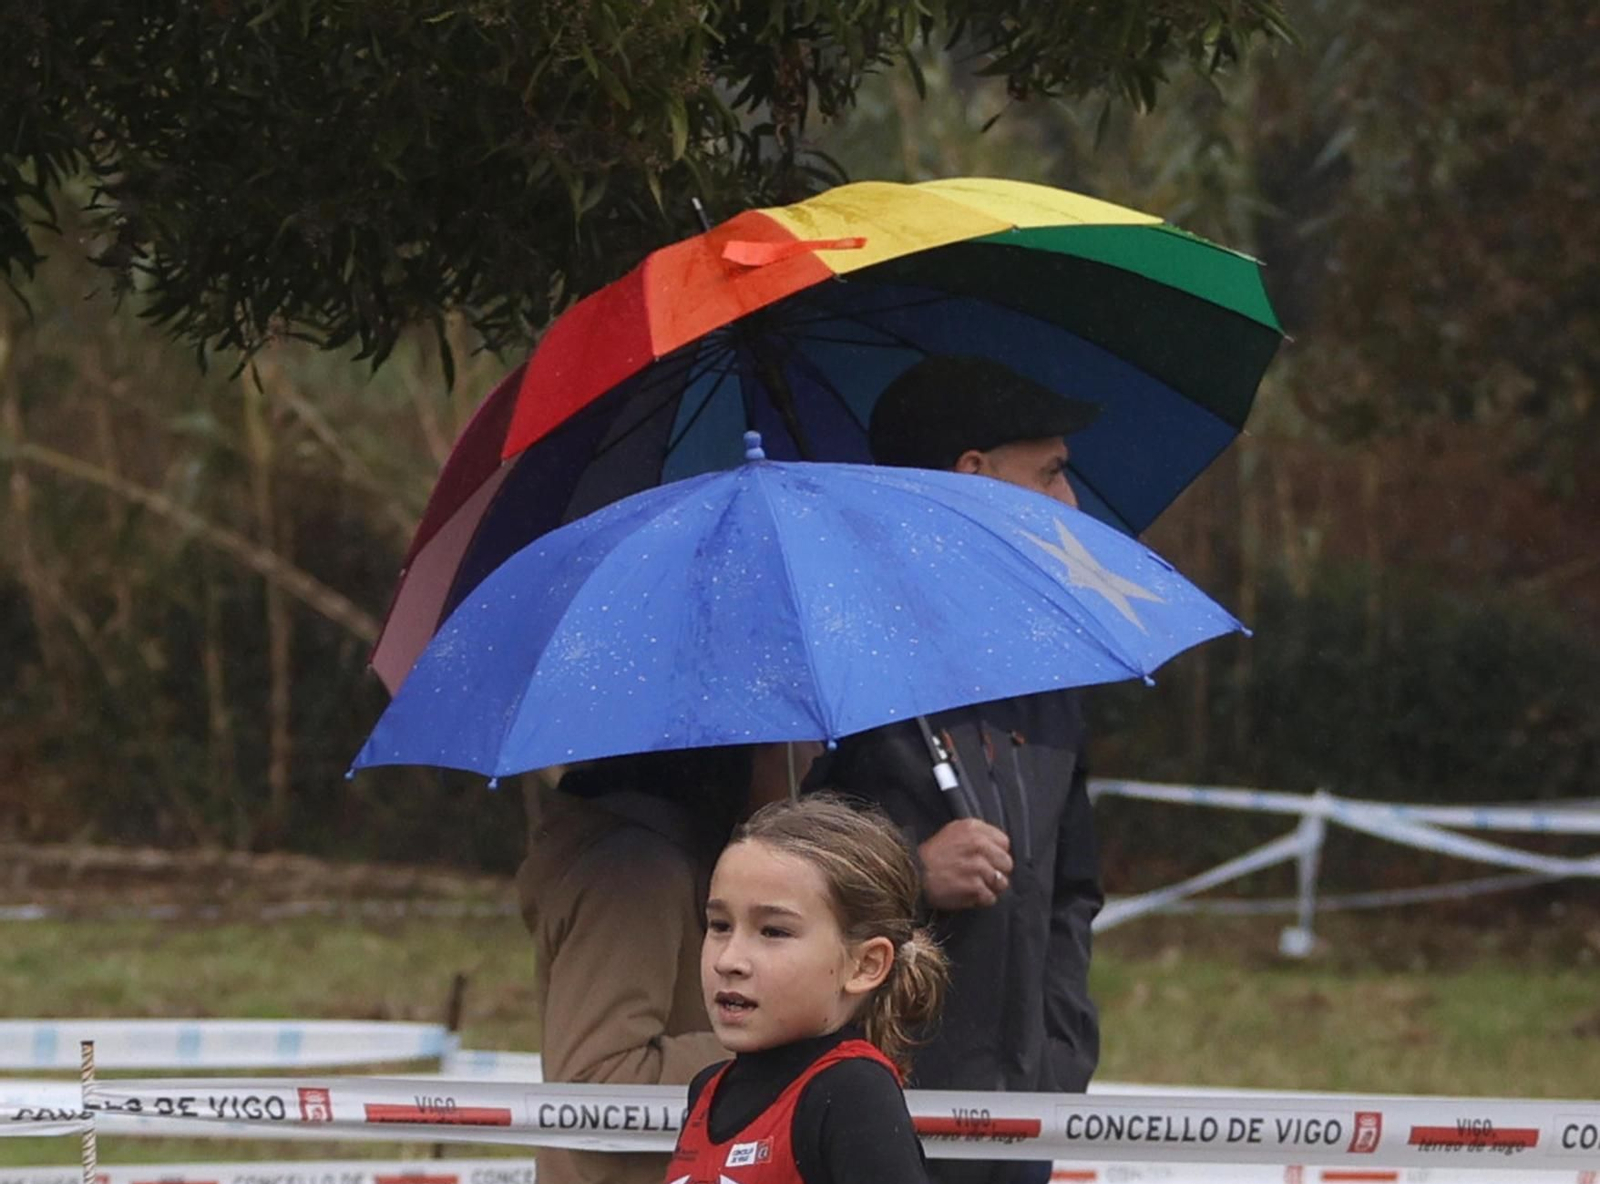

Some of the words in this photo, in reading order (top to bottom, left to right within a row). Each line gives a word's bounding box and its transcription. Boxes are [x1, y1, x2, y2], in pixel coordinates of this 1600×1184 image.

[208, 1095, 286, 1120] VIGO
[1066, 1114, 1217, 1143] CONCELLO
[1227, 1118, 1262, 1143] DE
[1275, 1118, 1342, 1145] VIGO
[1562, 1123, 1600, 1150] CO
